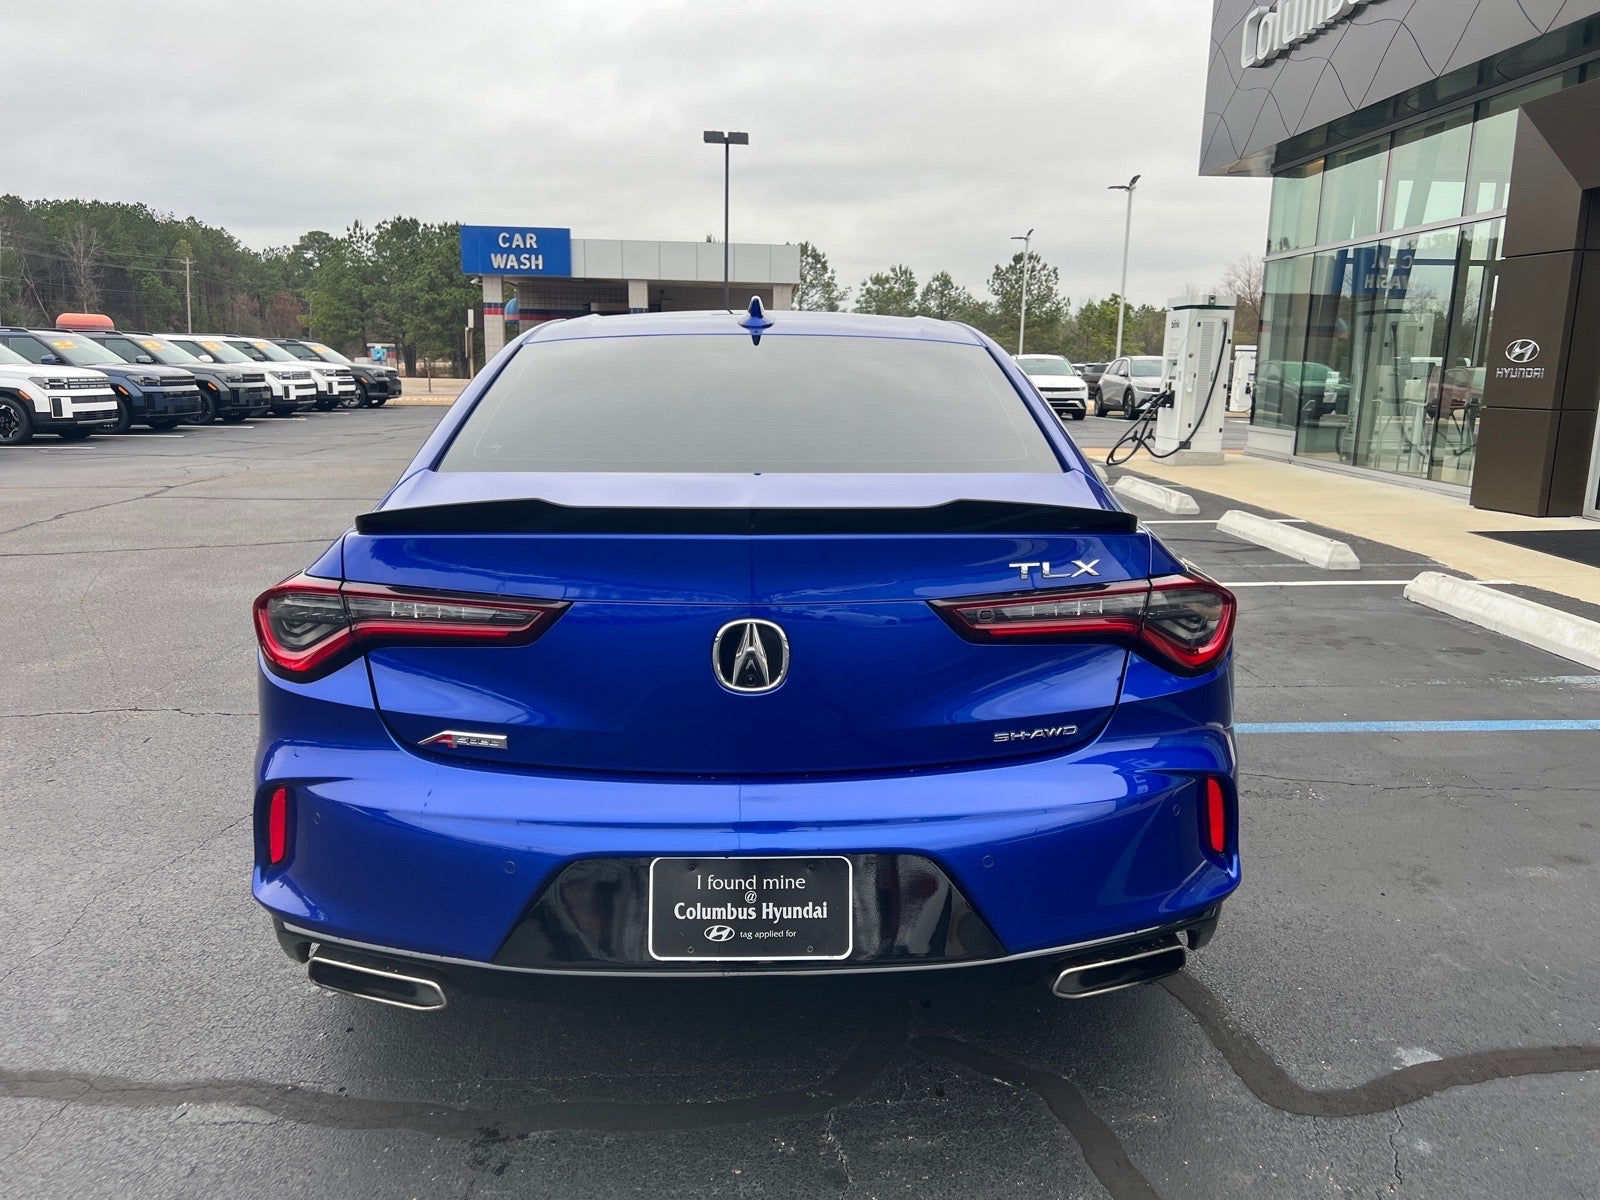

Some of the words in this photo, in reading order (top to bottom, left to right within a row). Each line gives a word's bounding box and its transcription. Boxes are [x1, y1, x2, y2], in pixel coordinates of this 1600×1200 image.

[498, 232, 538, 248] CAR
[490, 253, 544, 270] WASH
[1495, 367, 1545, 379] HYUNDAI
[1008, 558, 1101, 580] TLX
[993, 725, 1079, 743] SH-AWD
[697, 875, 702, 890] I
[707, 874, 757, 890] found
[763, 875, 806, 890] mine
[744, 890, 758, 904] @
[673, 902, 757, 920] Columbus
[761, 901, 828, 924] Hyundai
[739, 931, 753, 940] tag
[754, 929, 784, 939] applied
[785, 929, 797, 938] for
